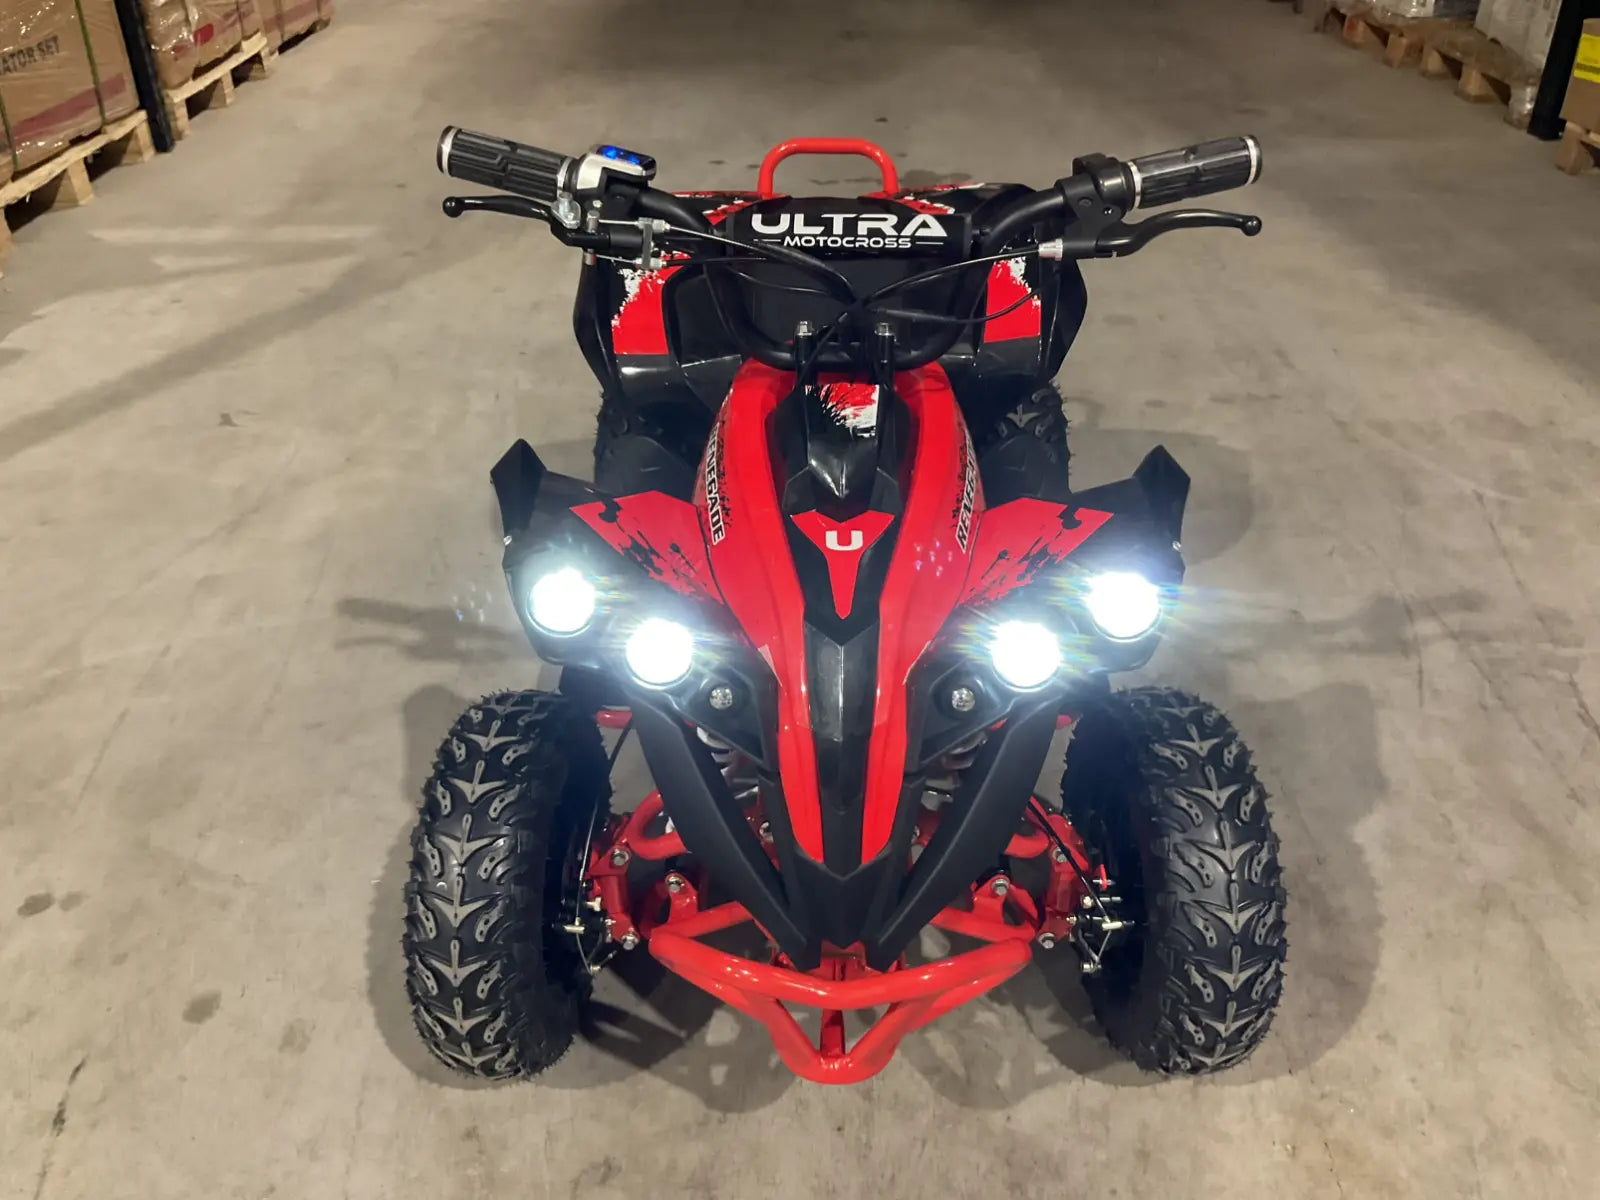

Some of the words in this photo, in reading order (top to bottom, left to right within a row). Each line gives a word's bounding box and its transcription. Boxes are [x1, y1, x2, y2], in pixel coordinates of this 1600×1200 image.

[0, 46, 37, 76] ATOR
[36, 35, 60, 59] SET
[751, 213, 948, 237] ULTRA
[783, 236, 912, 249] MOTOCROSS
[825, 530, 863, 551] U
